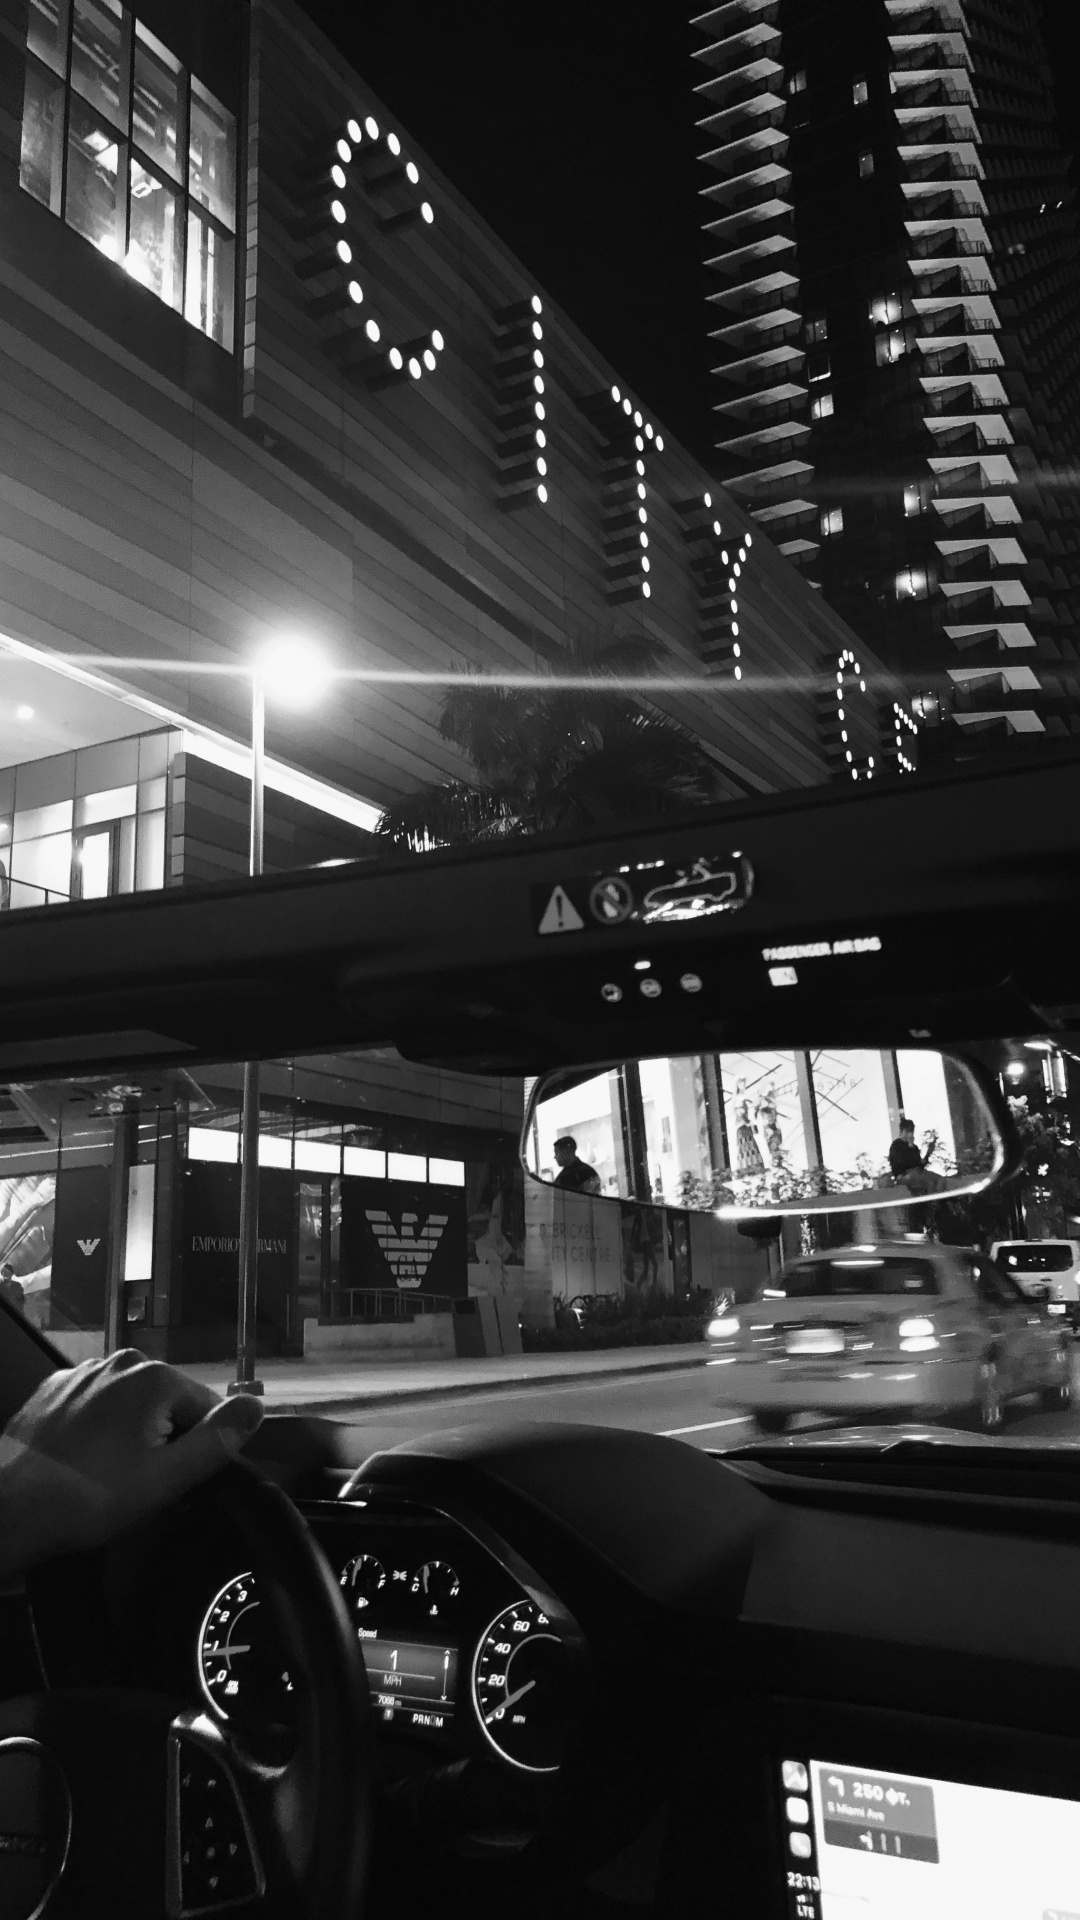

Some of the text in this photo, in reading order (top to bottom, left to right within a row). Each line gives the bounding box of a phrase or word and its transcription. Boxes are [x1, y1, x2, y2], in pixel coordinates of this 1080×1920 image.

[330, 113, 753, 681] CITY
[192, 1235, 287, 1254] EMPORIO RMANI
[340, 1576, 348, 1585] E
[377, 1579, 386, 1589] F
[411, 1583, 420, 1593] C
[449, 1586, 460, 1596] H
[237, 1590, 248, 1602] 3
[219, 1610, 230, 1623] 2
[358, 1627, 378, 1639] Speed
[512, 1620, 530, 1633] 60
[212, 1640, 220, 1651] 1
[494, 1642, 512, 1655] 40
[390, 1649, 398, 1671] 1
[216, 1669, 228, 1683] 0
[383, 1674, 402, 1687] MPH
[488, 1673, 506, 1687] 20
[852, 1782, 885, 1802] 250
[827, 1801, 885, 1822] S Miami Ave
[787, 1871, 821, 1892] 22:13
[797, 1904, 815, 1919] LTE
